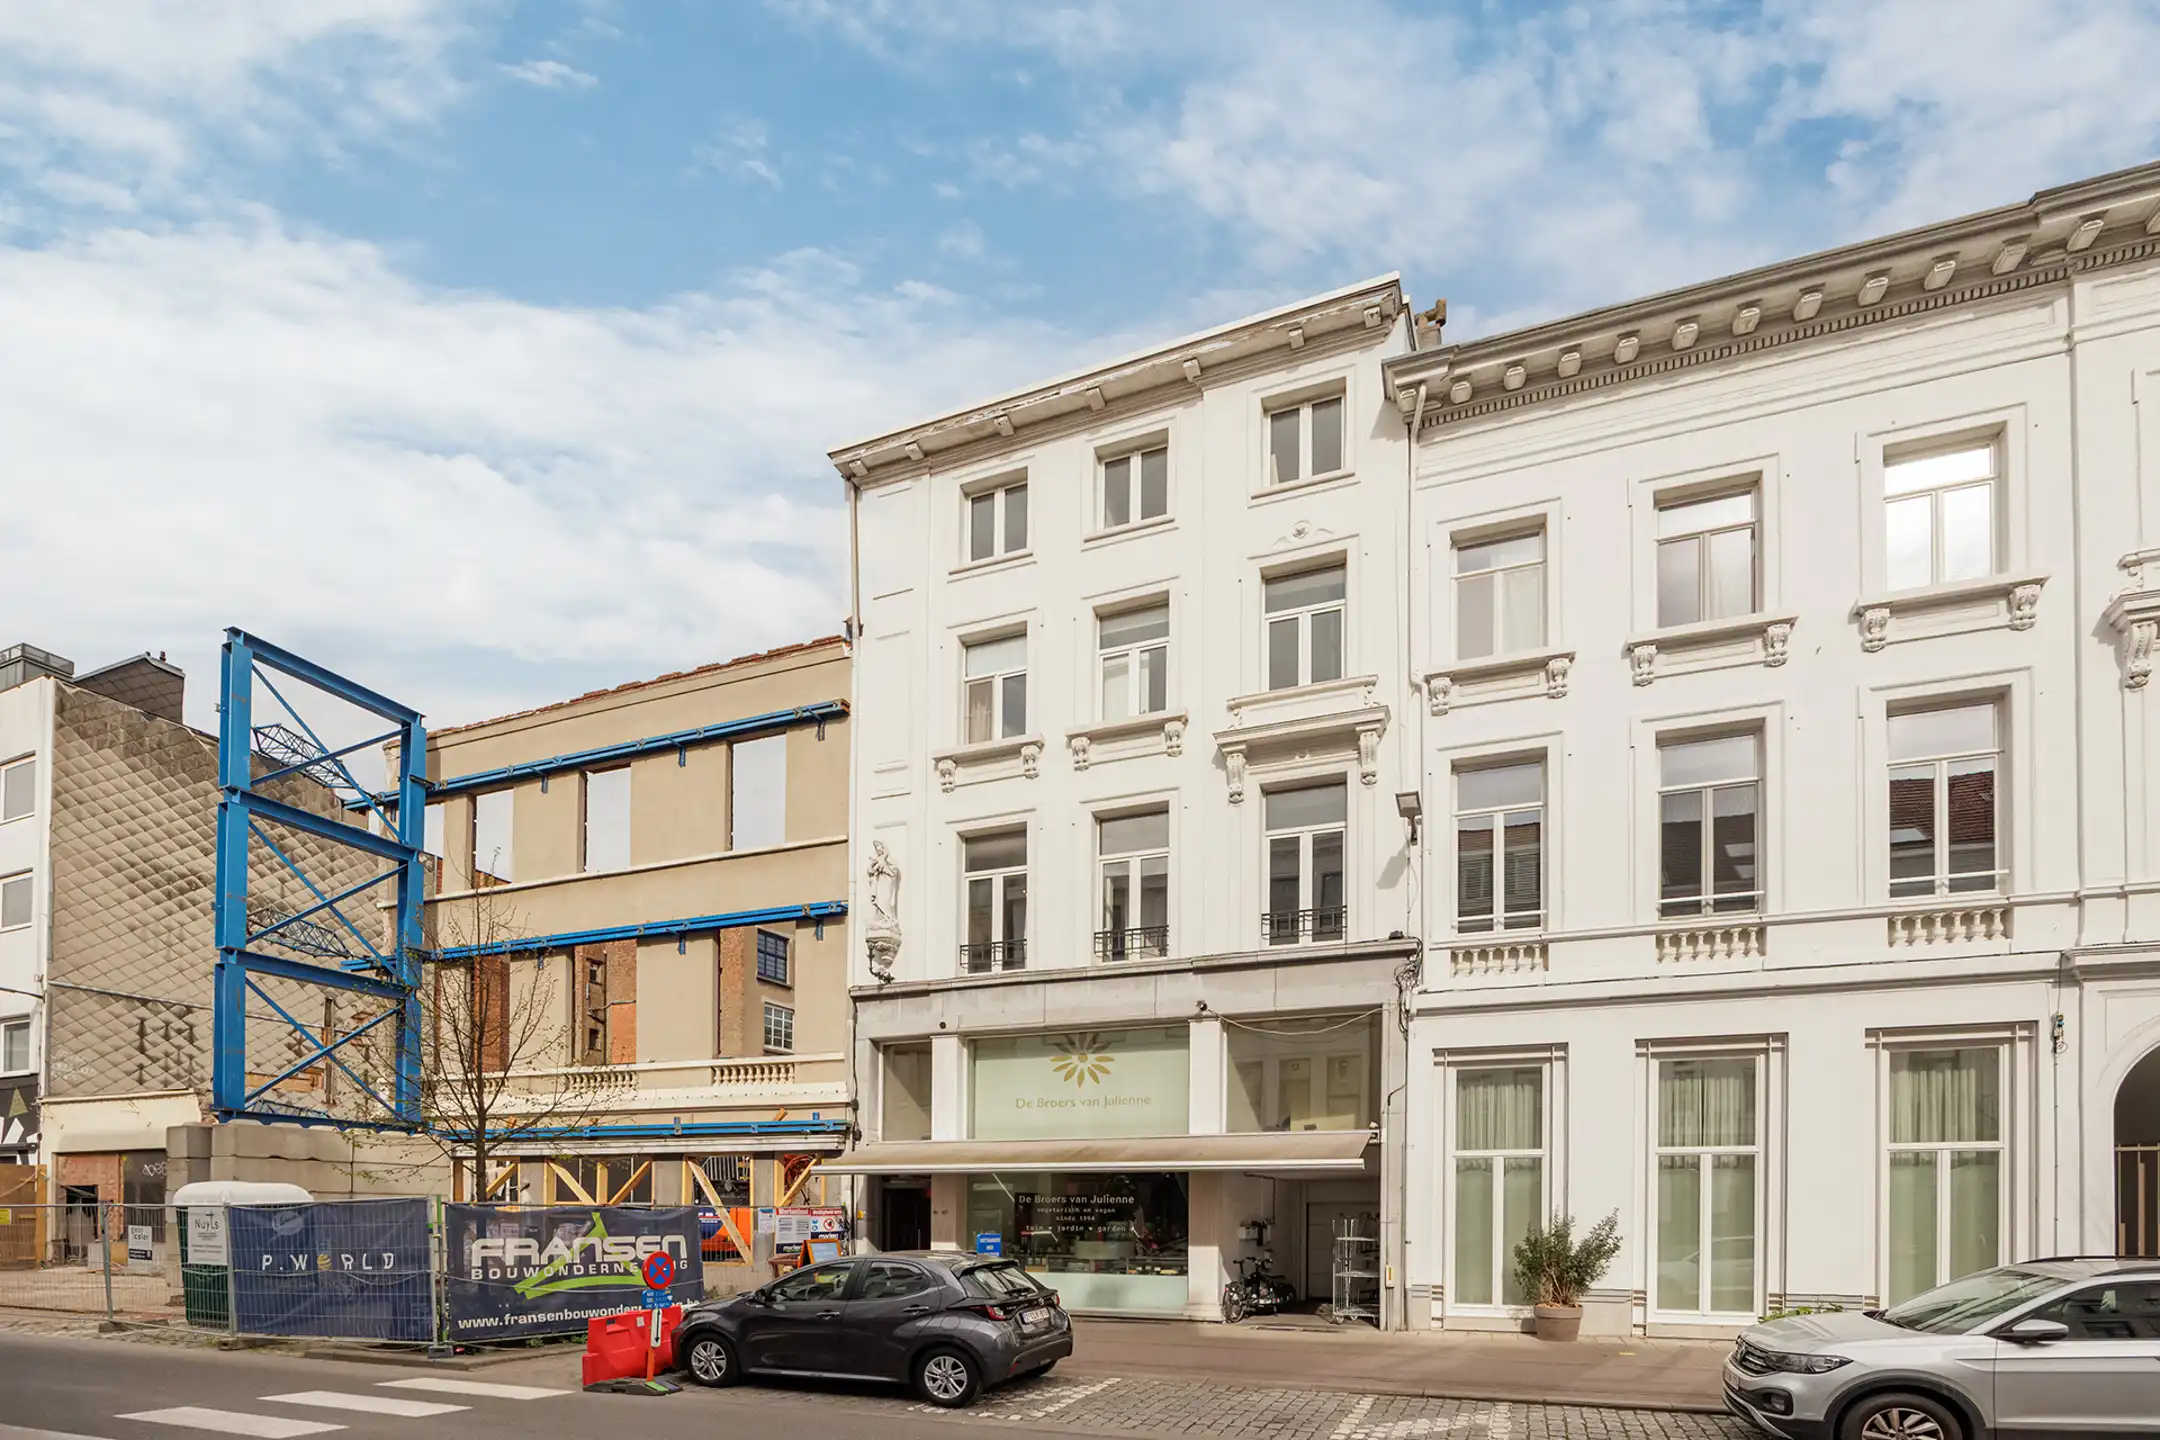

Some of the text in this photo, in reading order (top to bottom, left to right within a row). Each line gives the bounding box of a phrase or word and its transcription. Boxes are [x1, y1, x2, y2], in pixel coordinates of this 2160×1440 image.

[1015, 1094, 1151, 1109] De Broers van Julienne
[1019, 1194, 1135, 1204] De Broers van Julienne
[1036, 1206, 1080, 1214] vegetarisch
[1056, 1224, 1084, 1232] jardin
[471, 1235, 688, 1267] FRANSEN
[471, 1261, 688, 1280] BOUWONDERNEG
